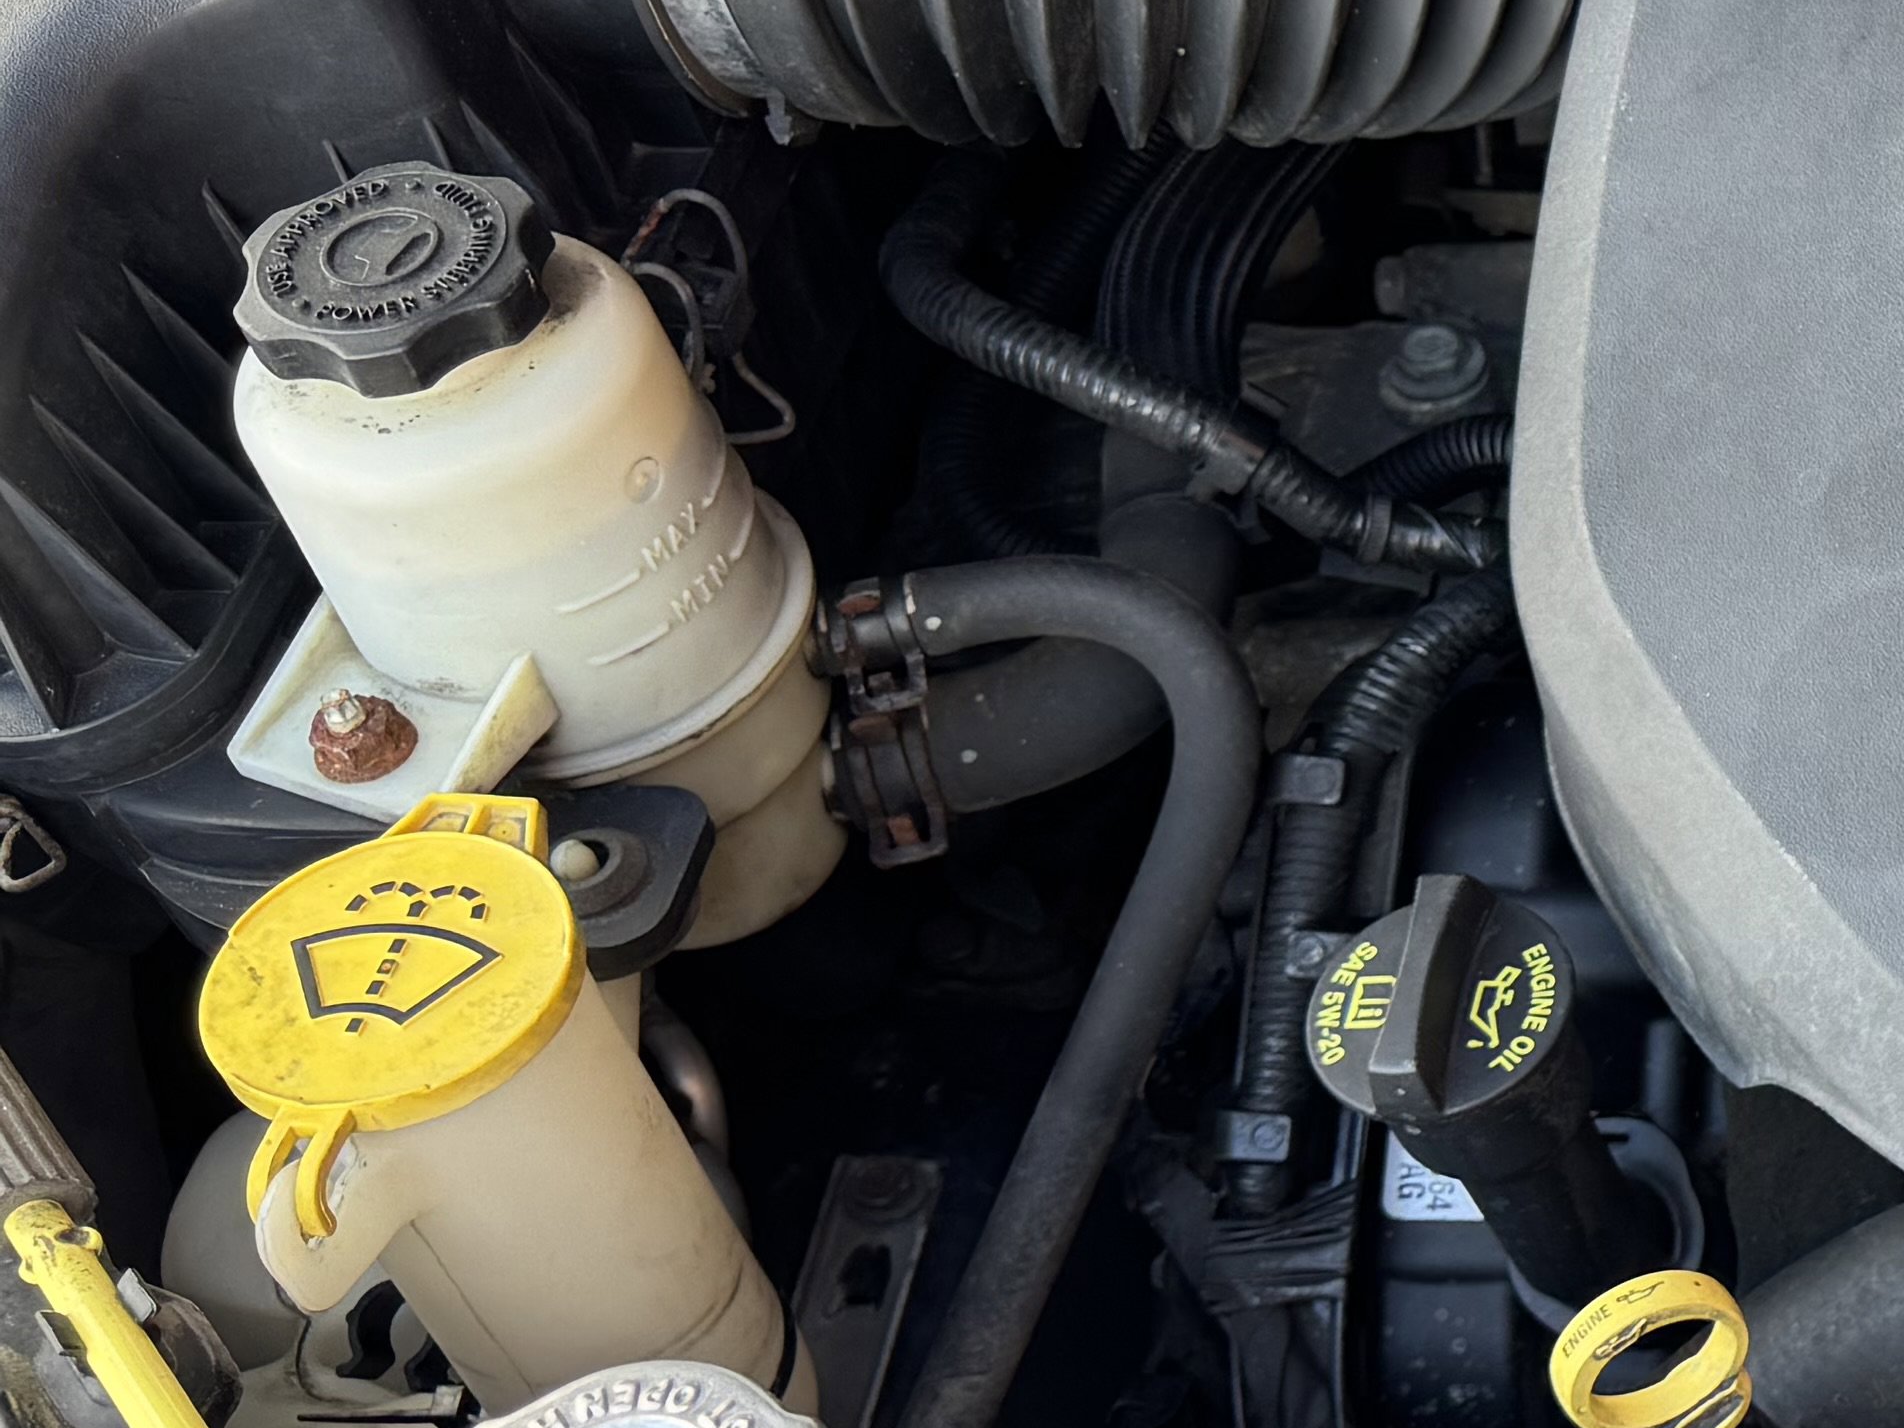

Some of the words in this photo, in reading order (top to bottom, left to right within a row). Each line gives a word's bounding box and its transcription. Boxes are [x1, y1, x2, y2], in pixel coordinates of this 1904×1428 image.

[270, 179, 391, 258] APPROVED
[315, 296, 418, 321] POWER
[641, 501, 702, 573] MAX
[670, 553, 730, 624] MIN
[1332, 941, 1378, 987] SAE
[1521, 943, 1556, 1033] ENGINE
[1315, 990, 1347, 1066] 5W-20
[1488, 1035, 1535, 1072] OIL
[1561, 1303, 1613, 1358] ENGINE
[572, 1377, 701, 1426] OPEN
